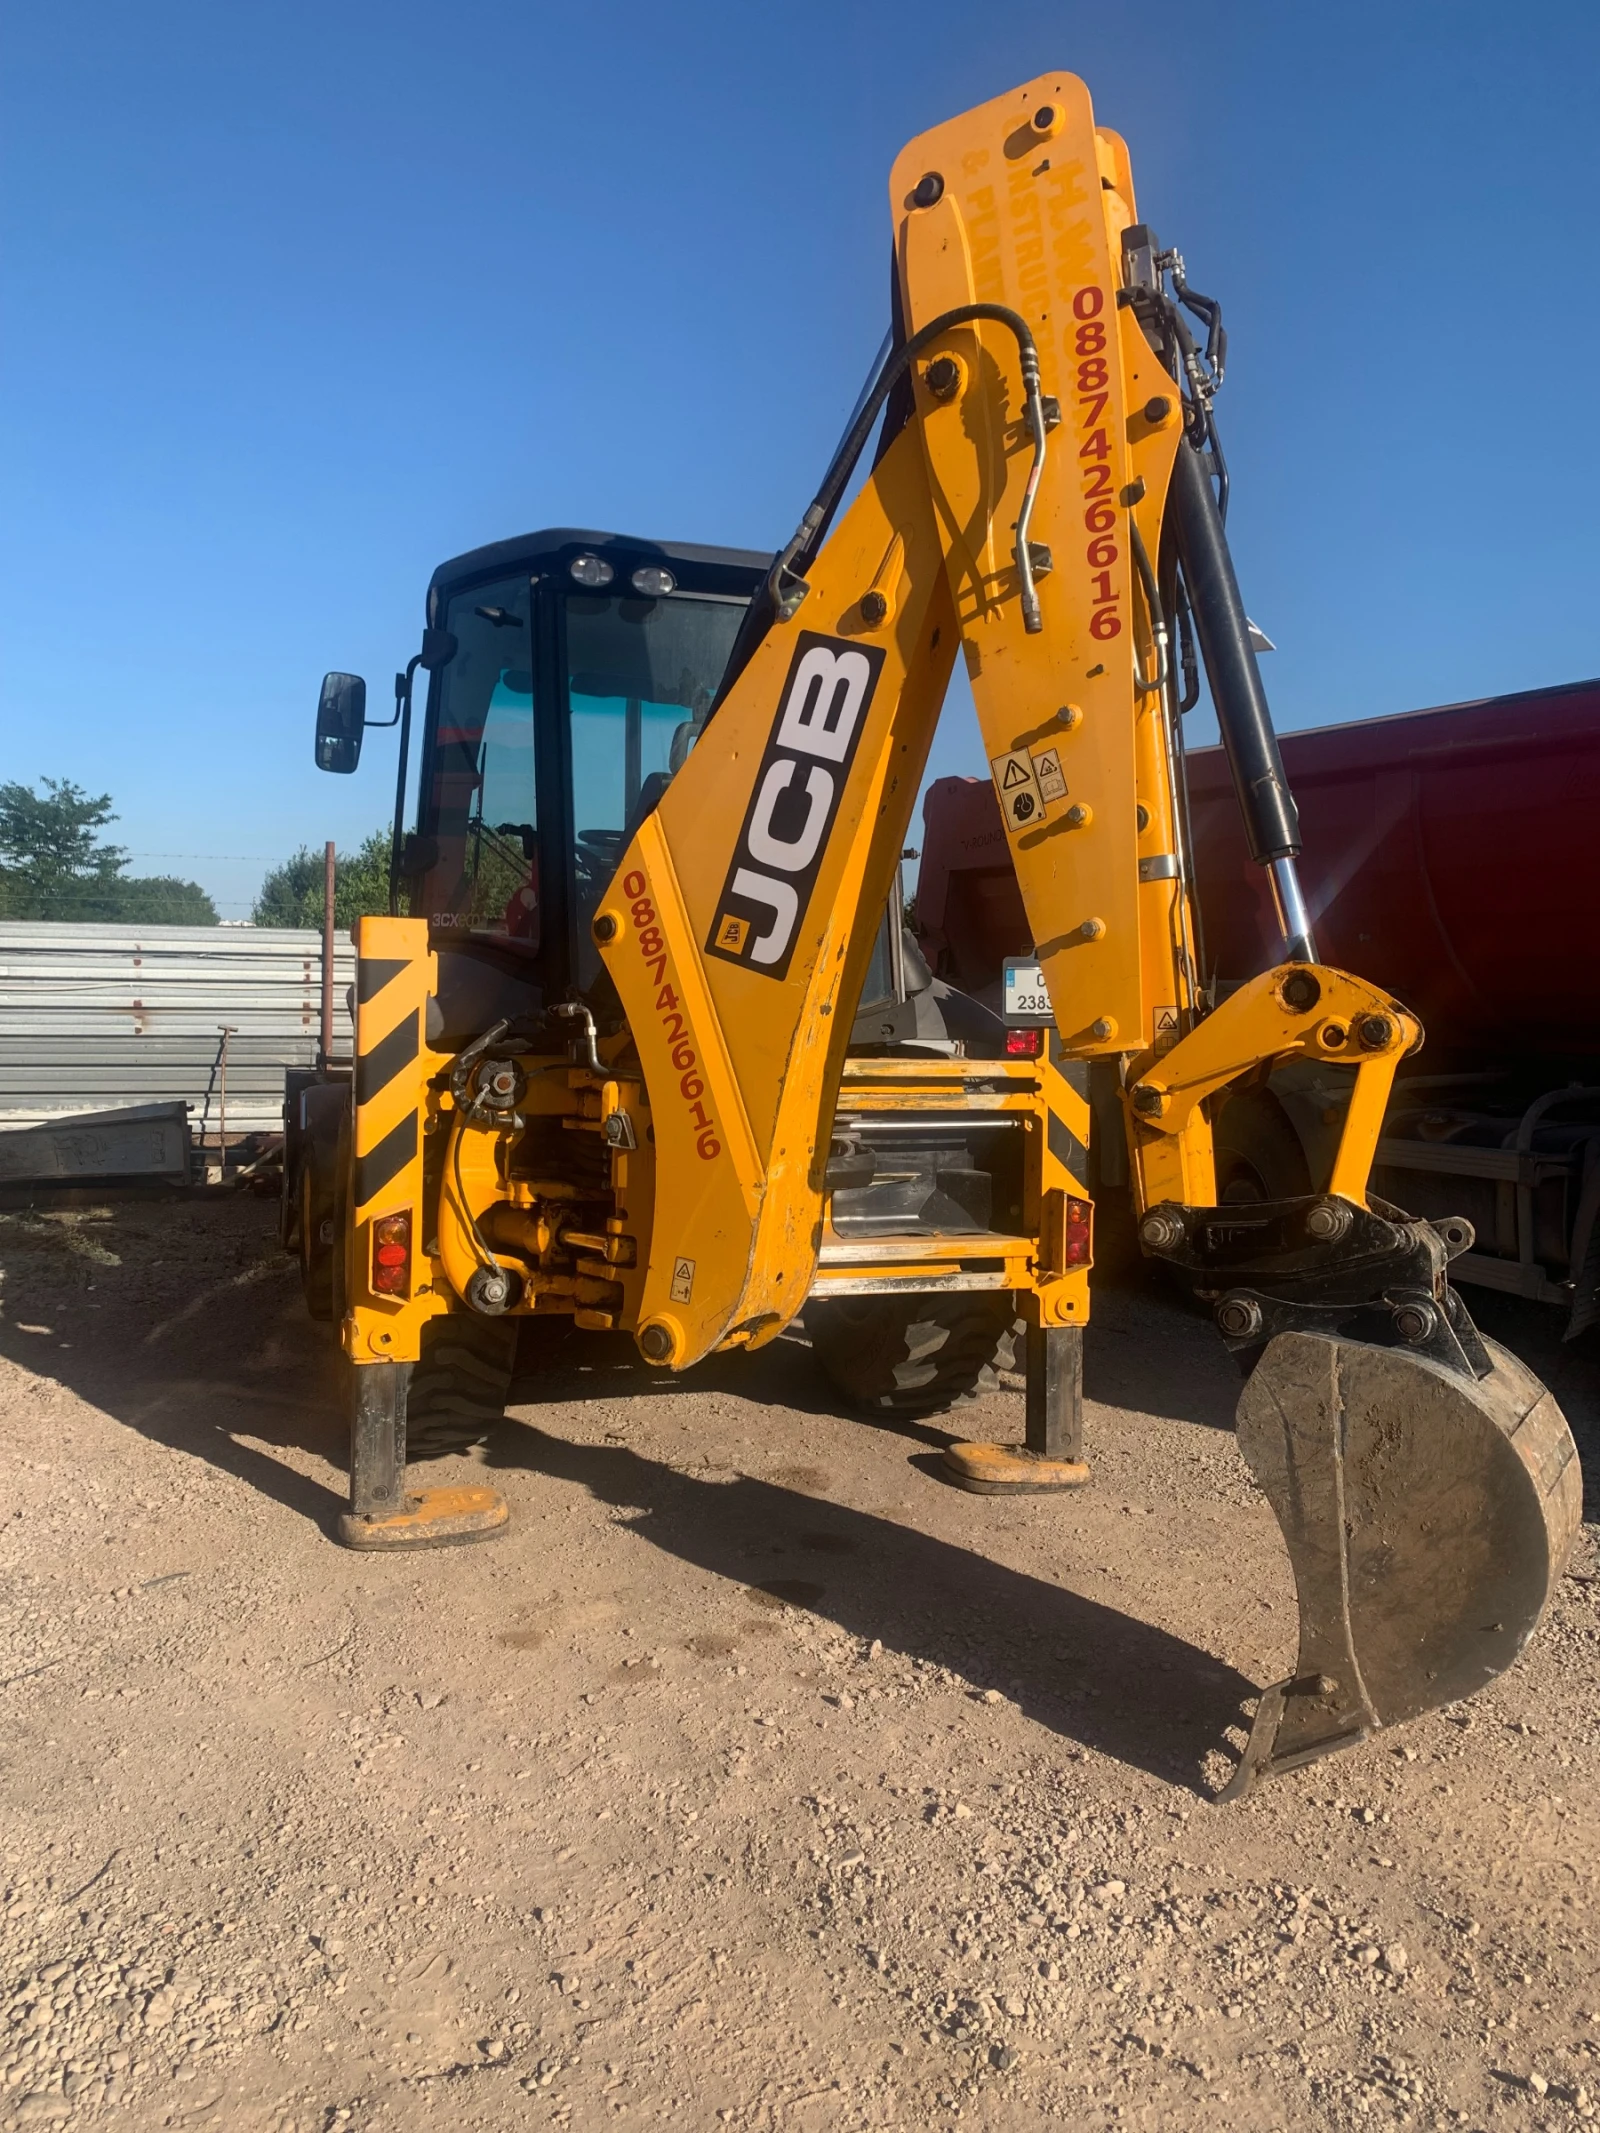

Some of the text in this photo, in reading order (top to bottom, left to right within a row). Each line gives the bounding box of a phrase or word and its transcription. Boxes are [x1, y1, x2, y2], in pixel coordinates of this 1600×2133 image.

[1072, 286, 1122, 641] 0887426616
[724, 923, 739, 942] JCB
[731, 646, 870, 965] JCB
[622, 870, 722, 1161] 0887426616
